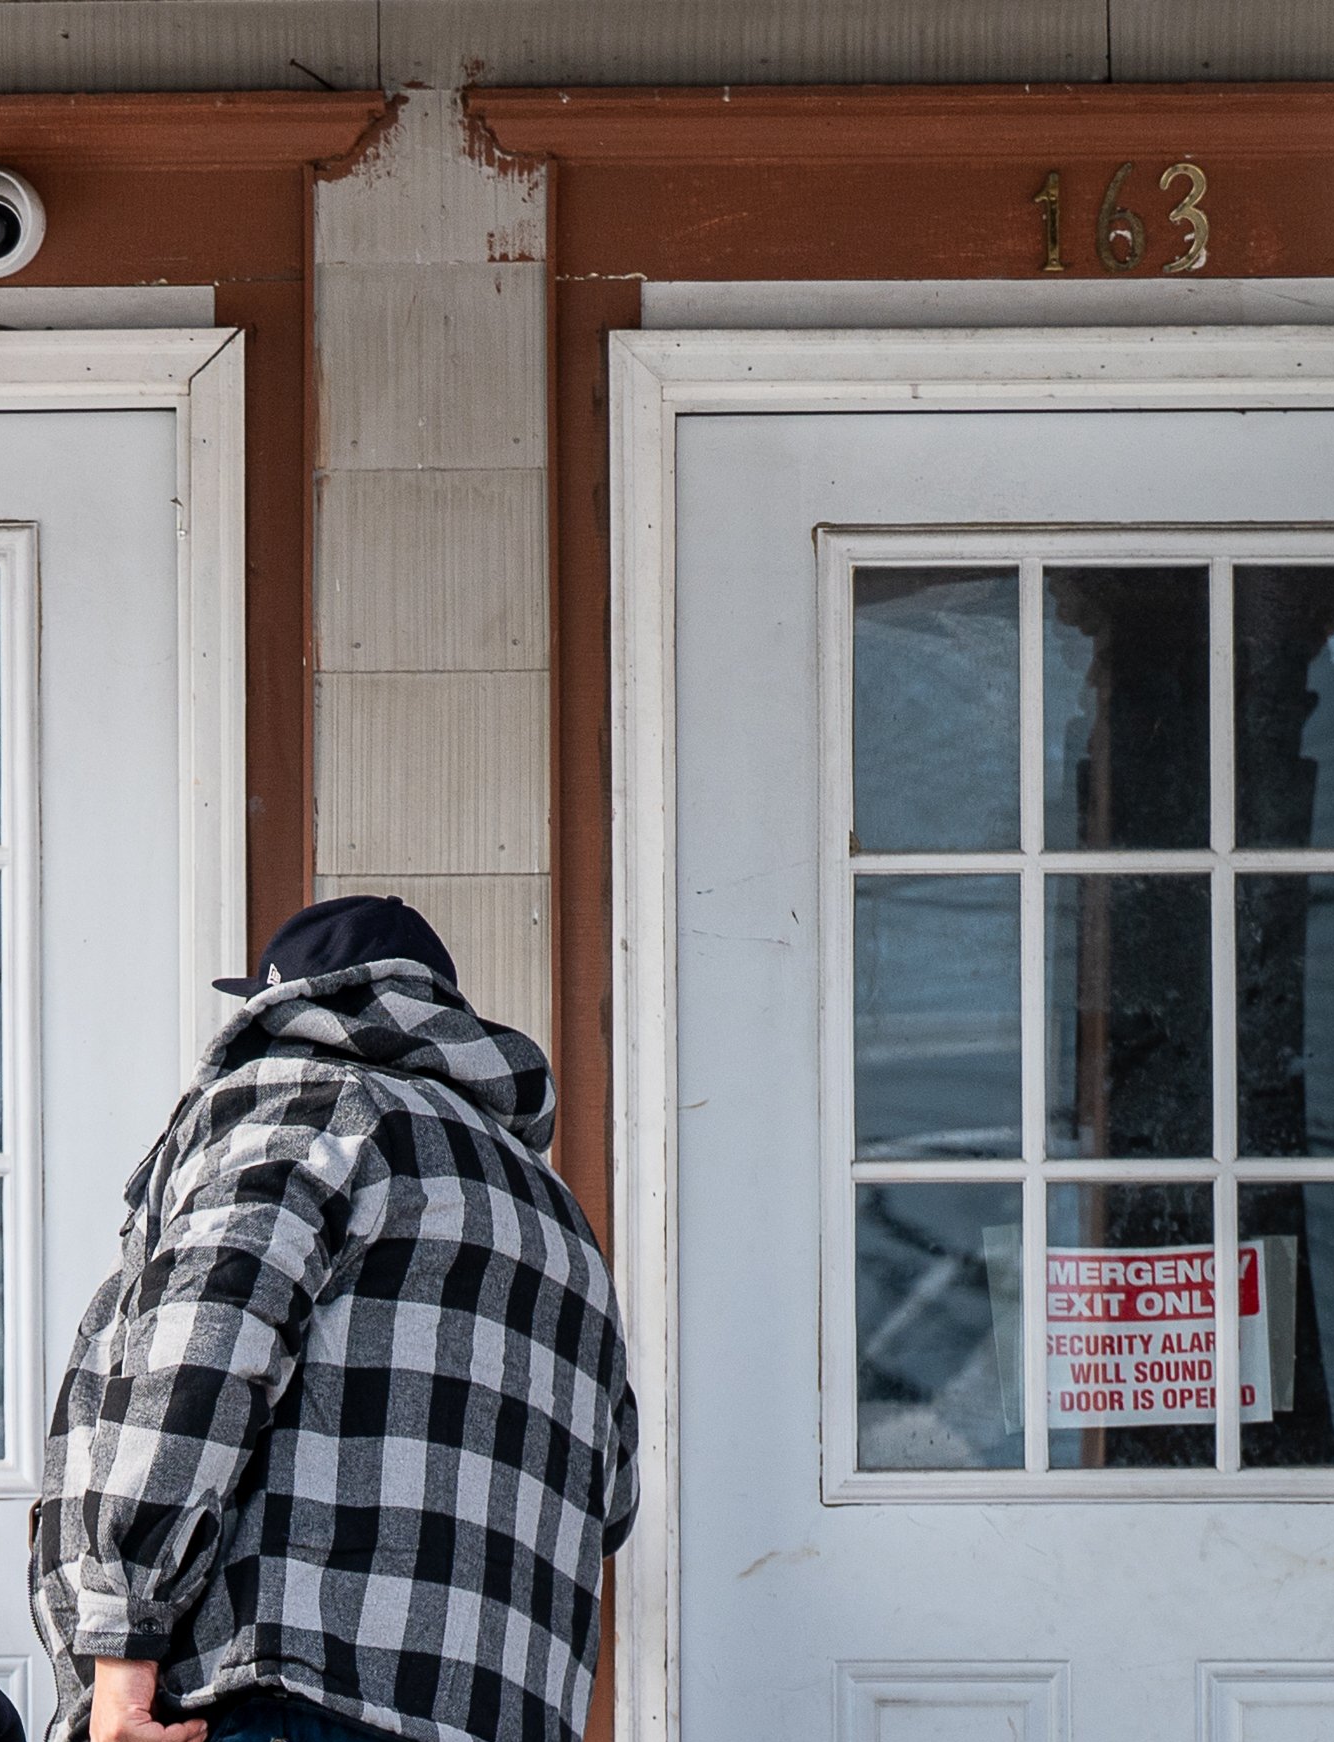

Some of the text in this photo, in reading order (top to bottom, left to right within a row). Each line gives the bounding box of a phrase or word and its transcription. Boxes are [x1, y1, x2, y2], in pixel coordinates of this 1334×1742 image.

[1034, 162, 1209, 272] 163
[1048, 1254, 1252, 1286] MERGEN
[1047, 1290, 1215, 1317] EXIT ONL
[1161, 1331, 1241, 1355] ALAR
[1070, 1359, 1212, 1384] WILL SOUND
[1060, 1390, 1125, 1412] DOOR
[1132, 1388, 1155, 1410] IS
[1162, 1384, 1256, 1410] OPED
